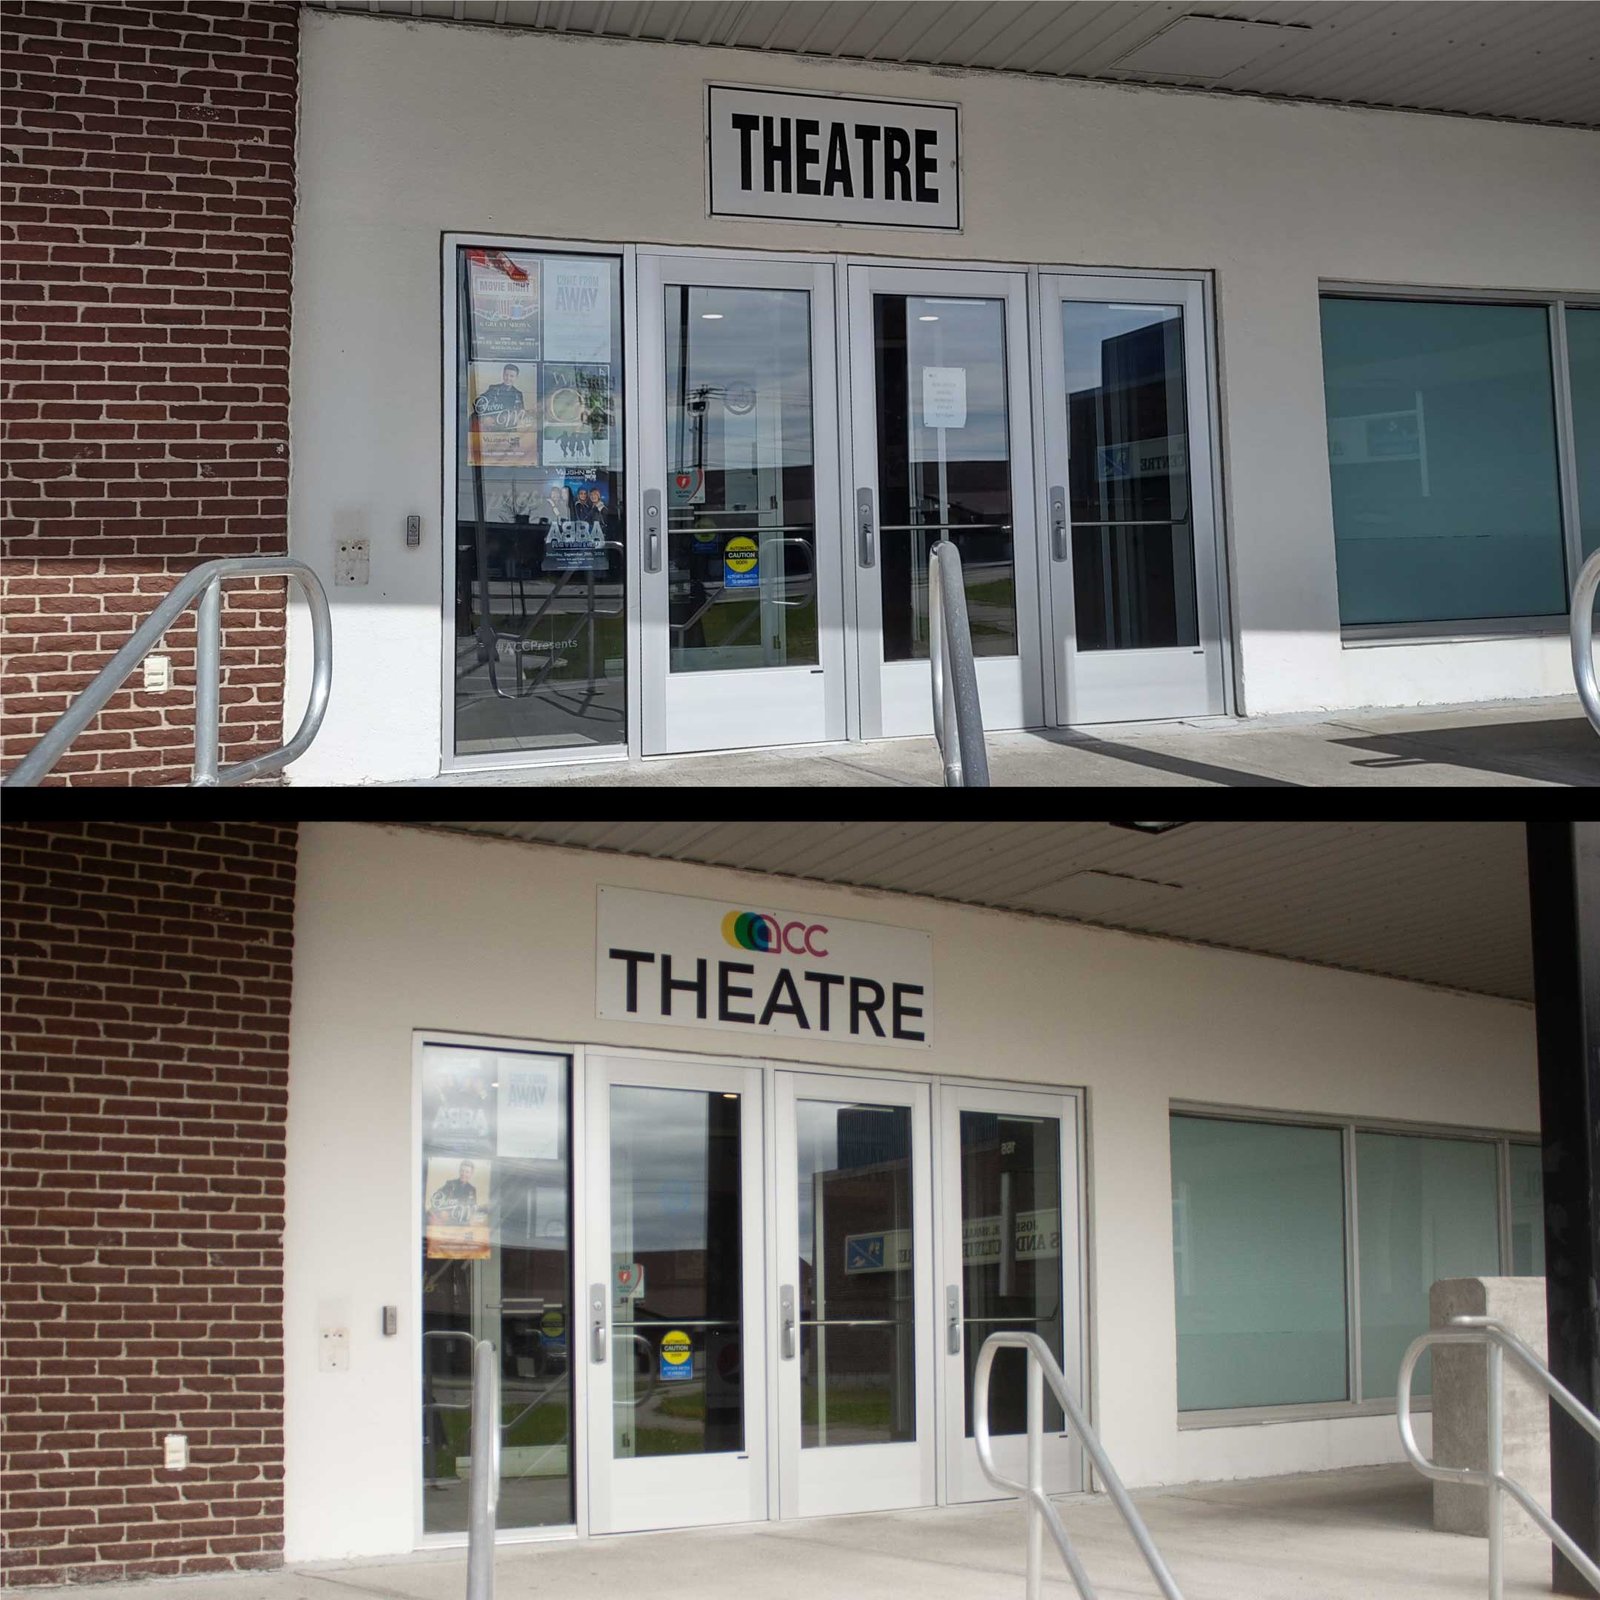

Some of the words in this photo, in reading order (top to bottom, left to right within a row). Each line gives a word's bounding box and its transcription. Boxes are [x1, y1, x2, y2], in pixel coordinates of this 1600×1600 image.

[732, 113, 938, 204] THEATRE
[479, 280, 506, 292] MOVIE
[554, 286, 599, 312] AWAY
[544, 520, 606, 543] ABBA
[495, 639, 578, 653] #ACCPresents
[609, 949, 925, 1042] THEATRE
[507, 1084, 547, 1108] AWAY
